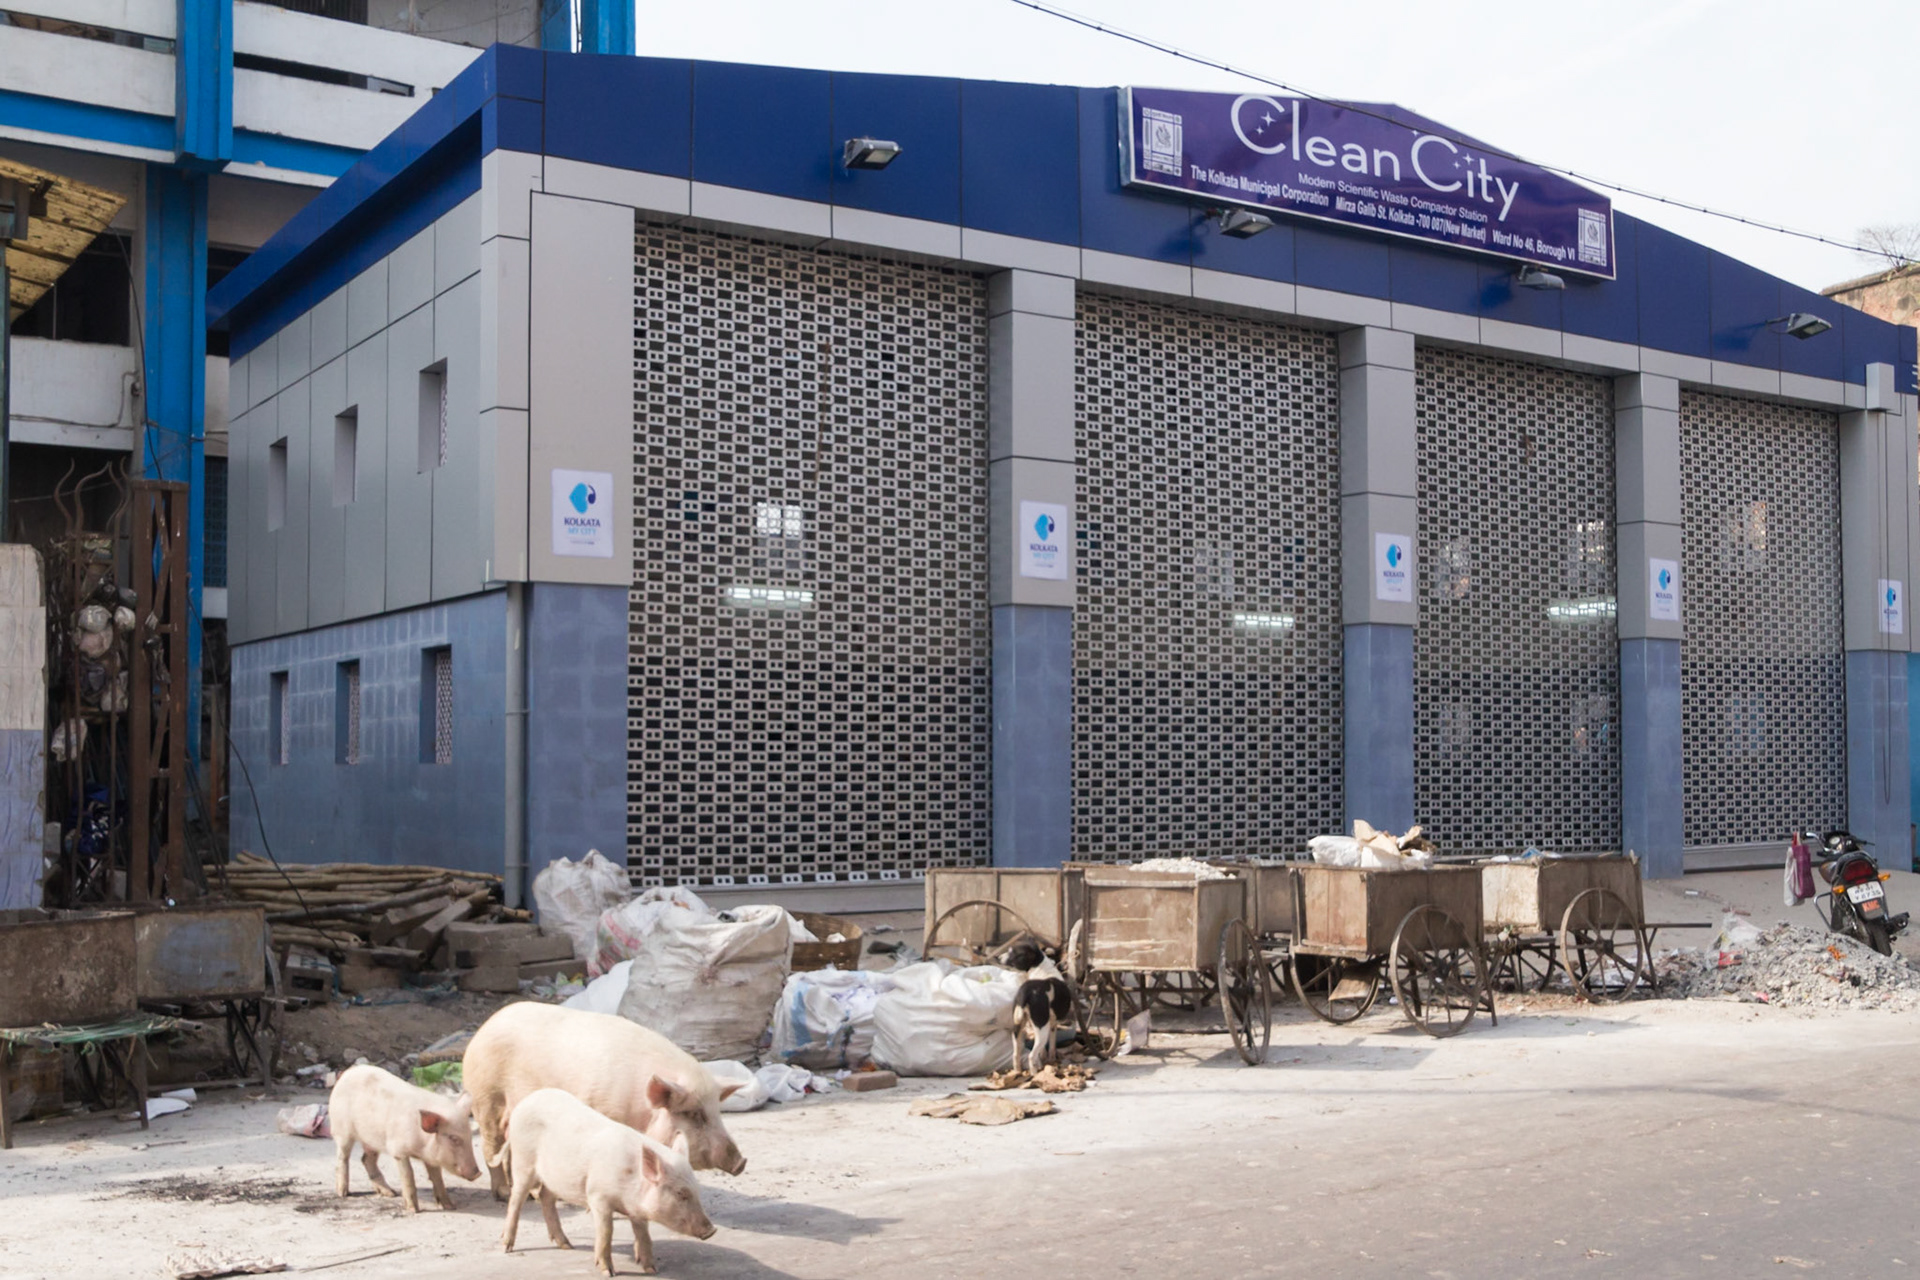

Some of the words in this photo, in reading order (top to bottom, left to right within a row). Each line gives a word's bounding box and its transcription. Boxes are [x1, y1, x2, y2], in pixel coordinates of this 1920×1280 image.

[1230, 93, 1401, 182] Clean
[1411, 135, 1519, 222] City
[1191, 164, 1207, 181] The
[1208, 168, 1239, 189] Kolkata
[1240, 176, 1281, 198] Municipal
[1282, 184, 1329, 207] Corporation
[1298, 172, 1336, 190] Modern
[1338, 180, 1379, 199] Scientific
[1381, 189, 1409, 206] Waste
[1410, 196, 1457, 215] Compactor
[1459, 207, 1488, 223] Station
[1335, 196, 1356, 213] Mirza
[1357, 200, 1376, 218] Galib
[1388, 208, 1415, 226] Kolkata
[1461, 222, 1487, 244] Market)
[1492, 229, 1512, 246] Ward
[1512, 234, 1524, 249] No
[1536, 240, 1567, 261] Borough
[1567, 247, 1575, 260] VI
[564, 517, 601, 527] KOLKATA
